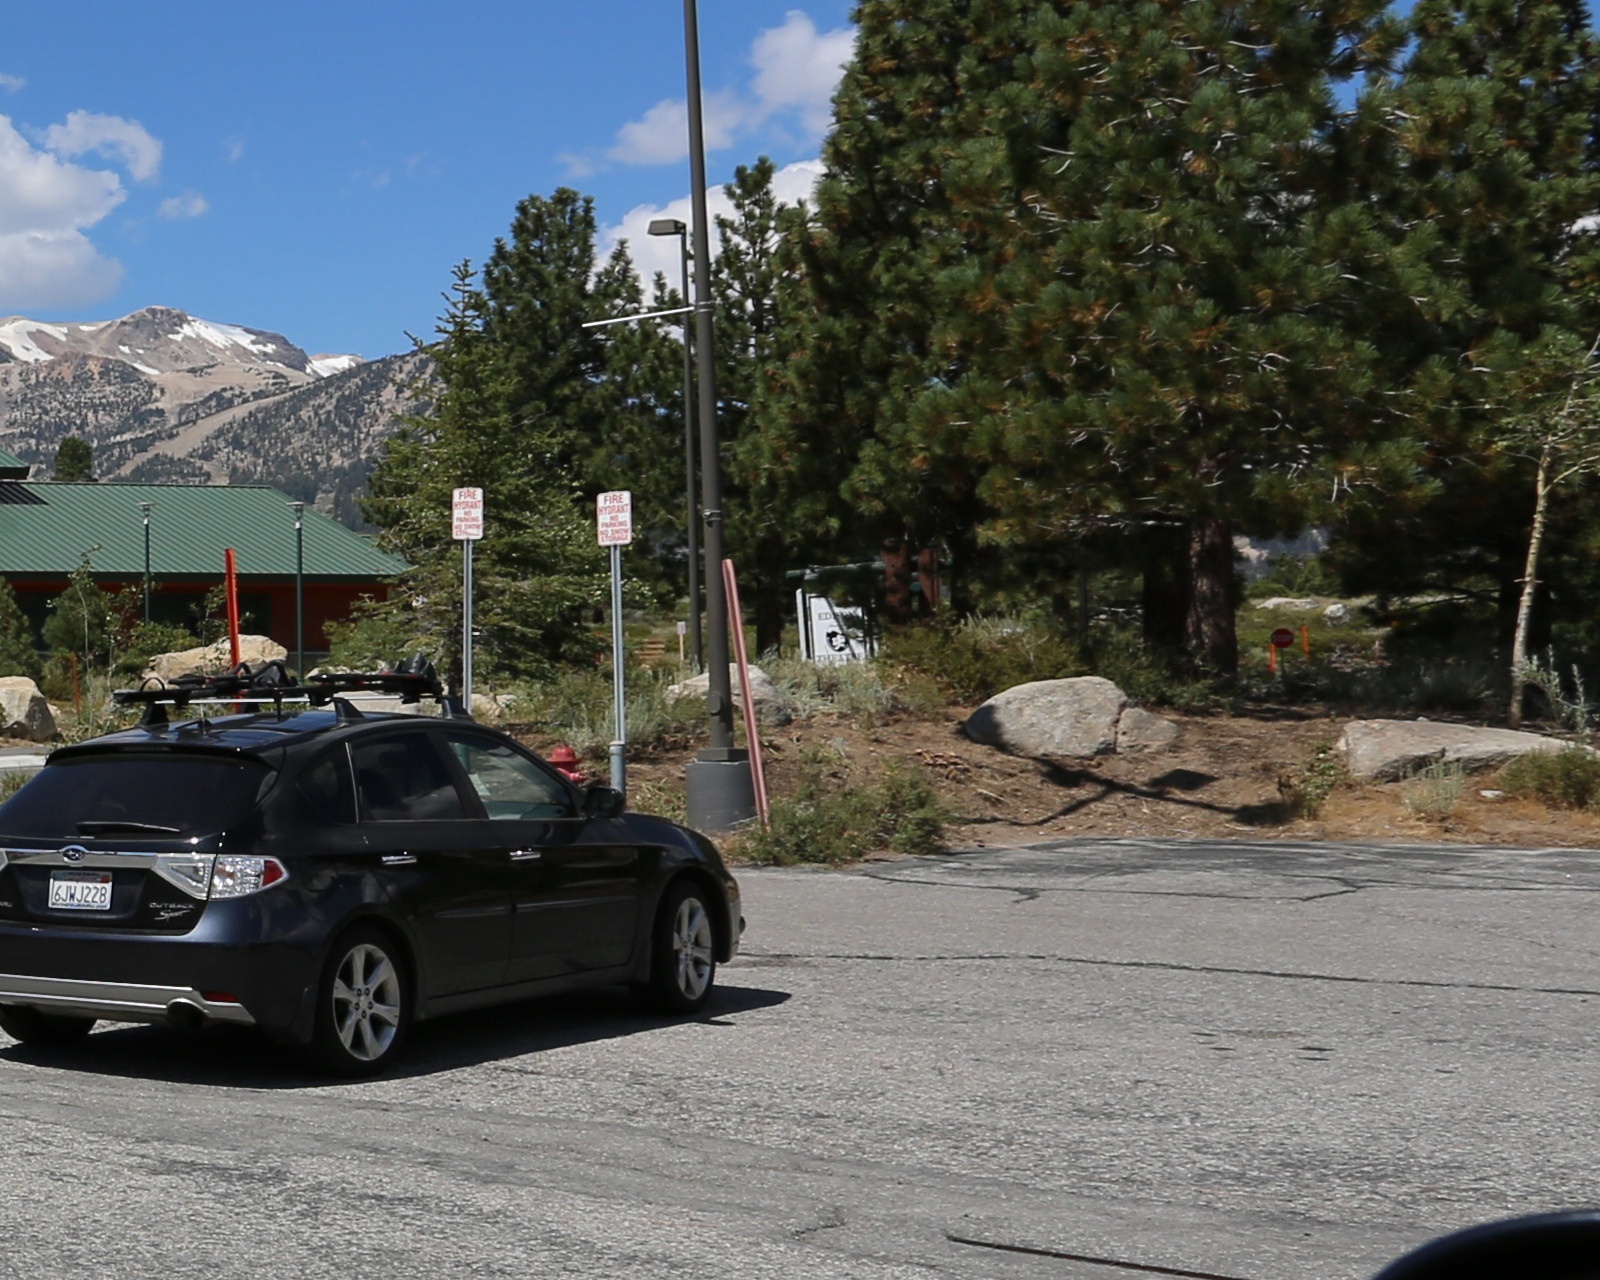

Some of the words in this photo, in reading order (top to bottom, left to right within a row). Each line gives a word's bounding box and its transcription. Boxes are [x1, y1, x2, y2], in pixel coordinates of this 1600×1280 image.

[459, 490, 477, 500] FIRE
[604, 493, 624, 505] FIRE
[453, 500, 481, 510] HYDRANT
[598, 503, 629, 515] HYDRANT
[54, 885, 107, 904] 6JWJ228
